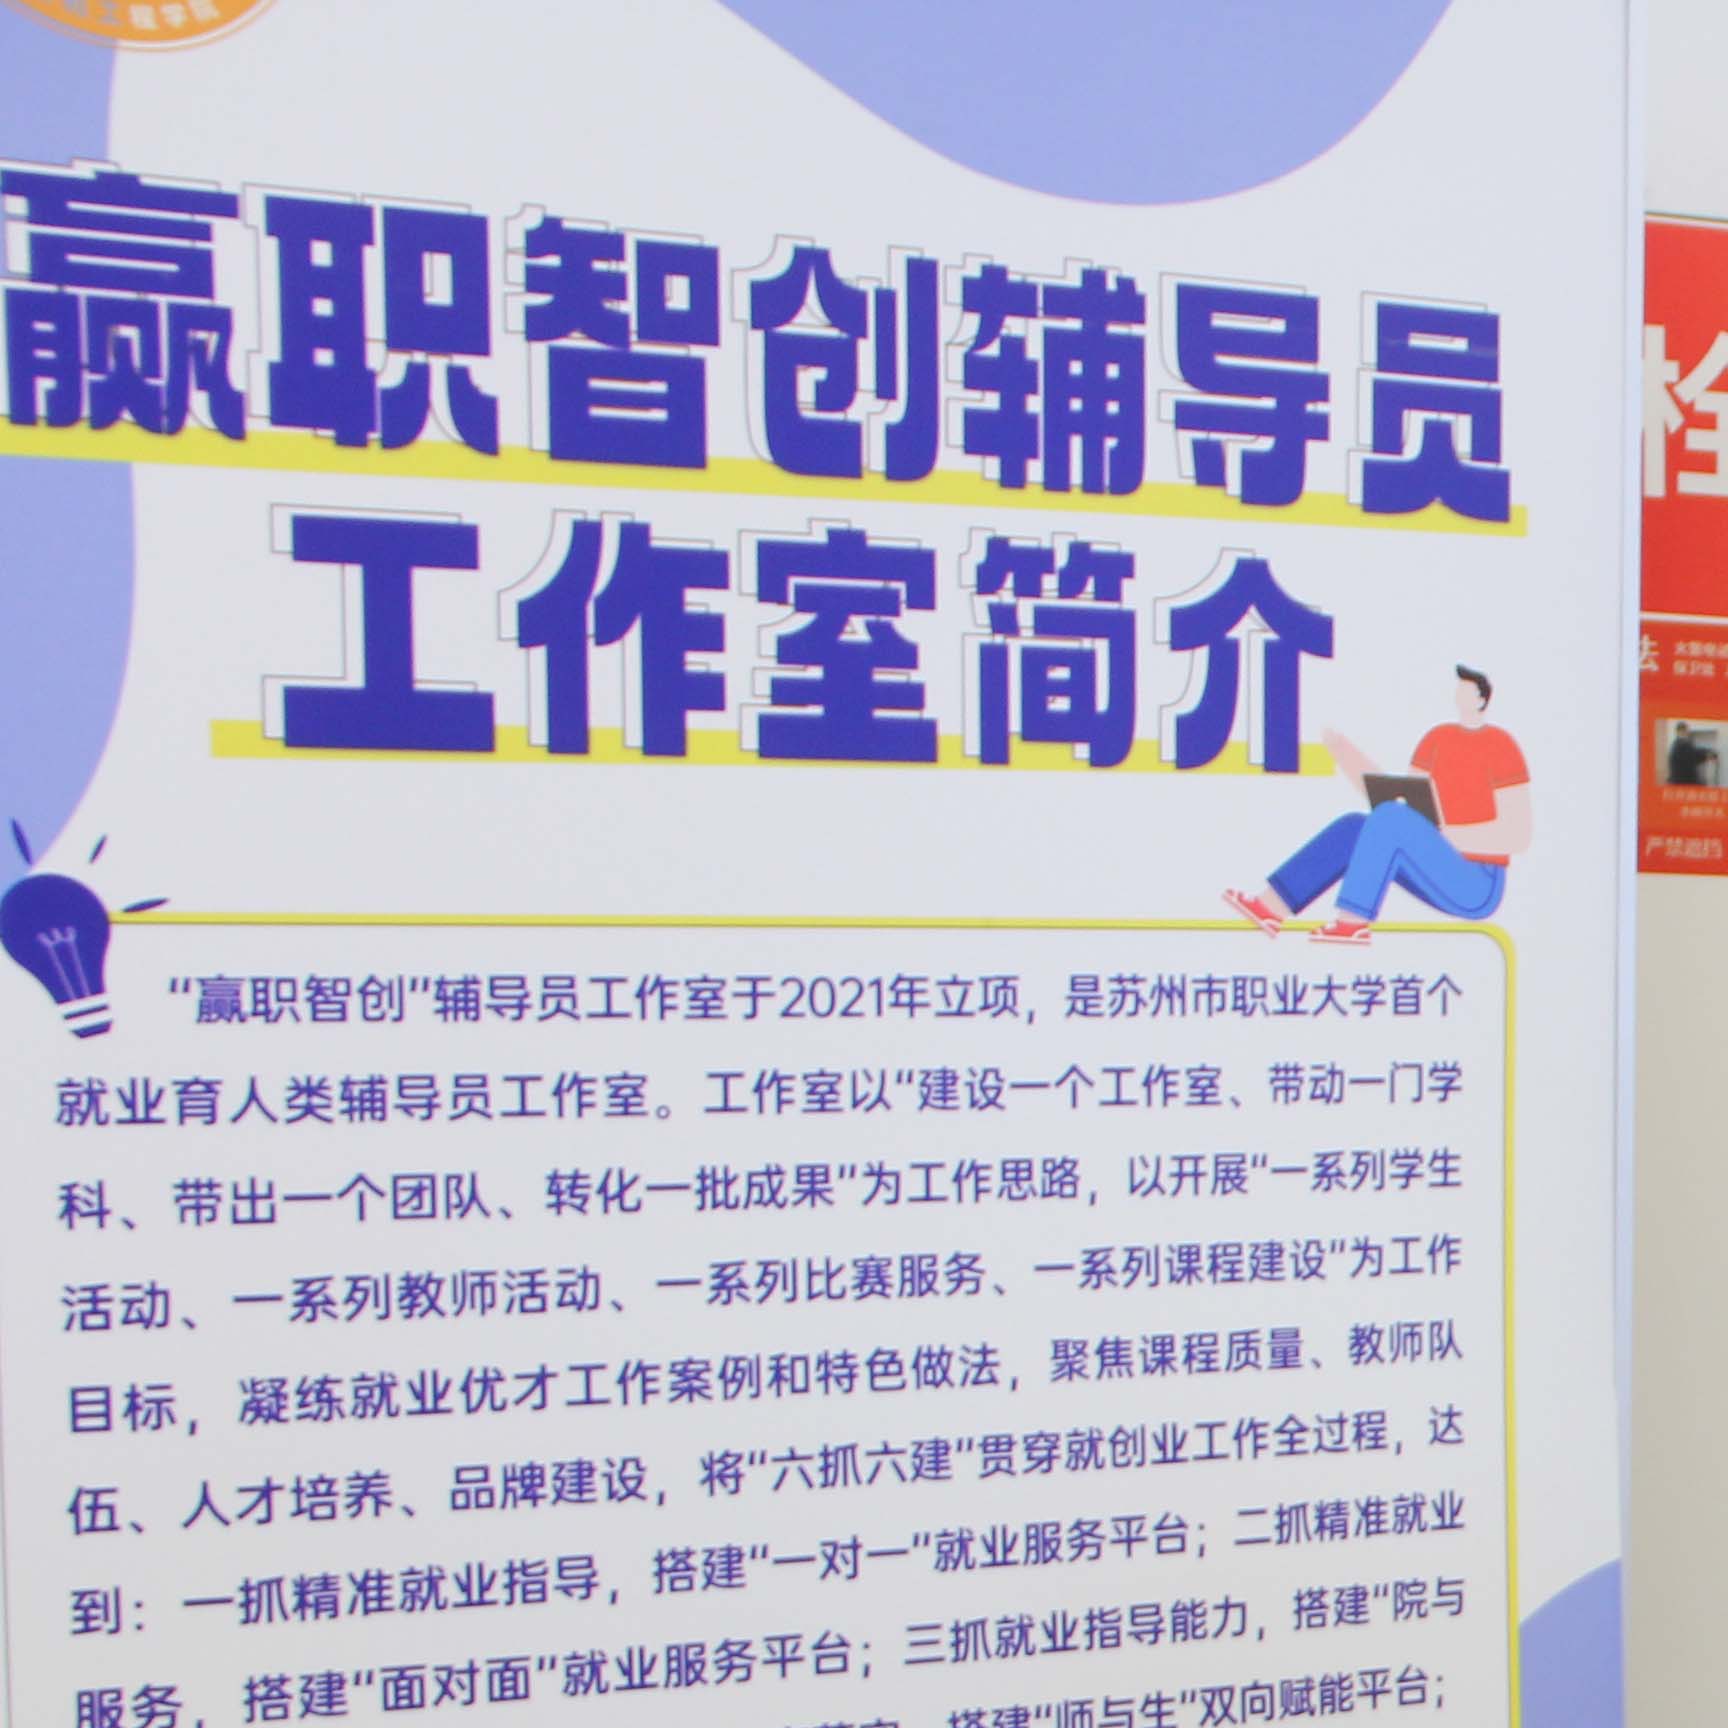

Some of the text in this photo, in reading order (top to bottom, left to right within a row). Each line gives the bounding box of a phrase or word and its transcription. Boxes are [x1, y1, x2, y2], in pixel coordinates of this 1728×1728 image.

[0, 160, 1514, 524] 赢职智创辅导员
[261, 502, 1336, 777] 工作室简介
